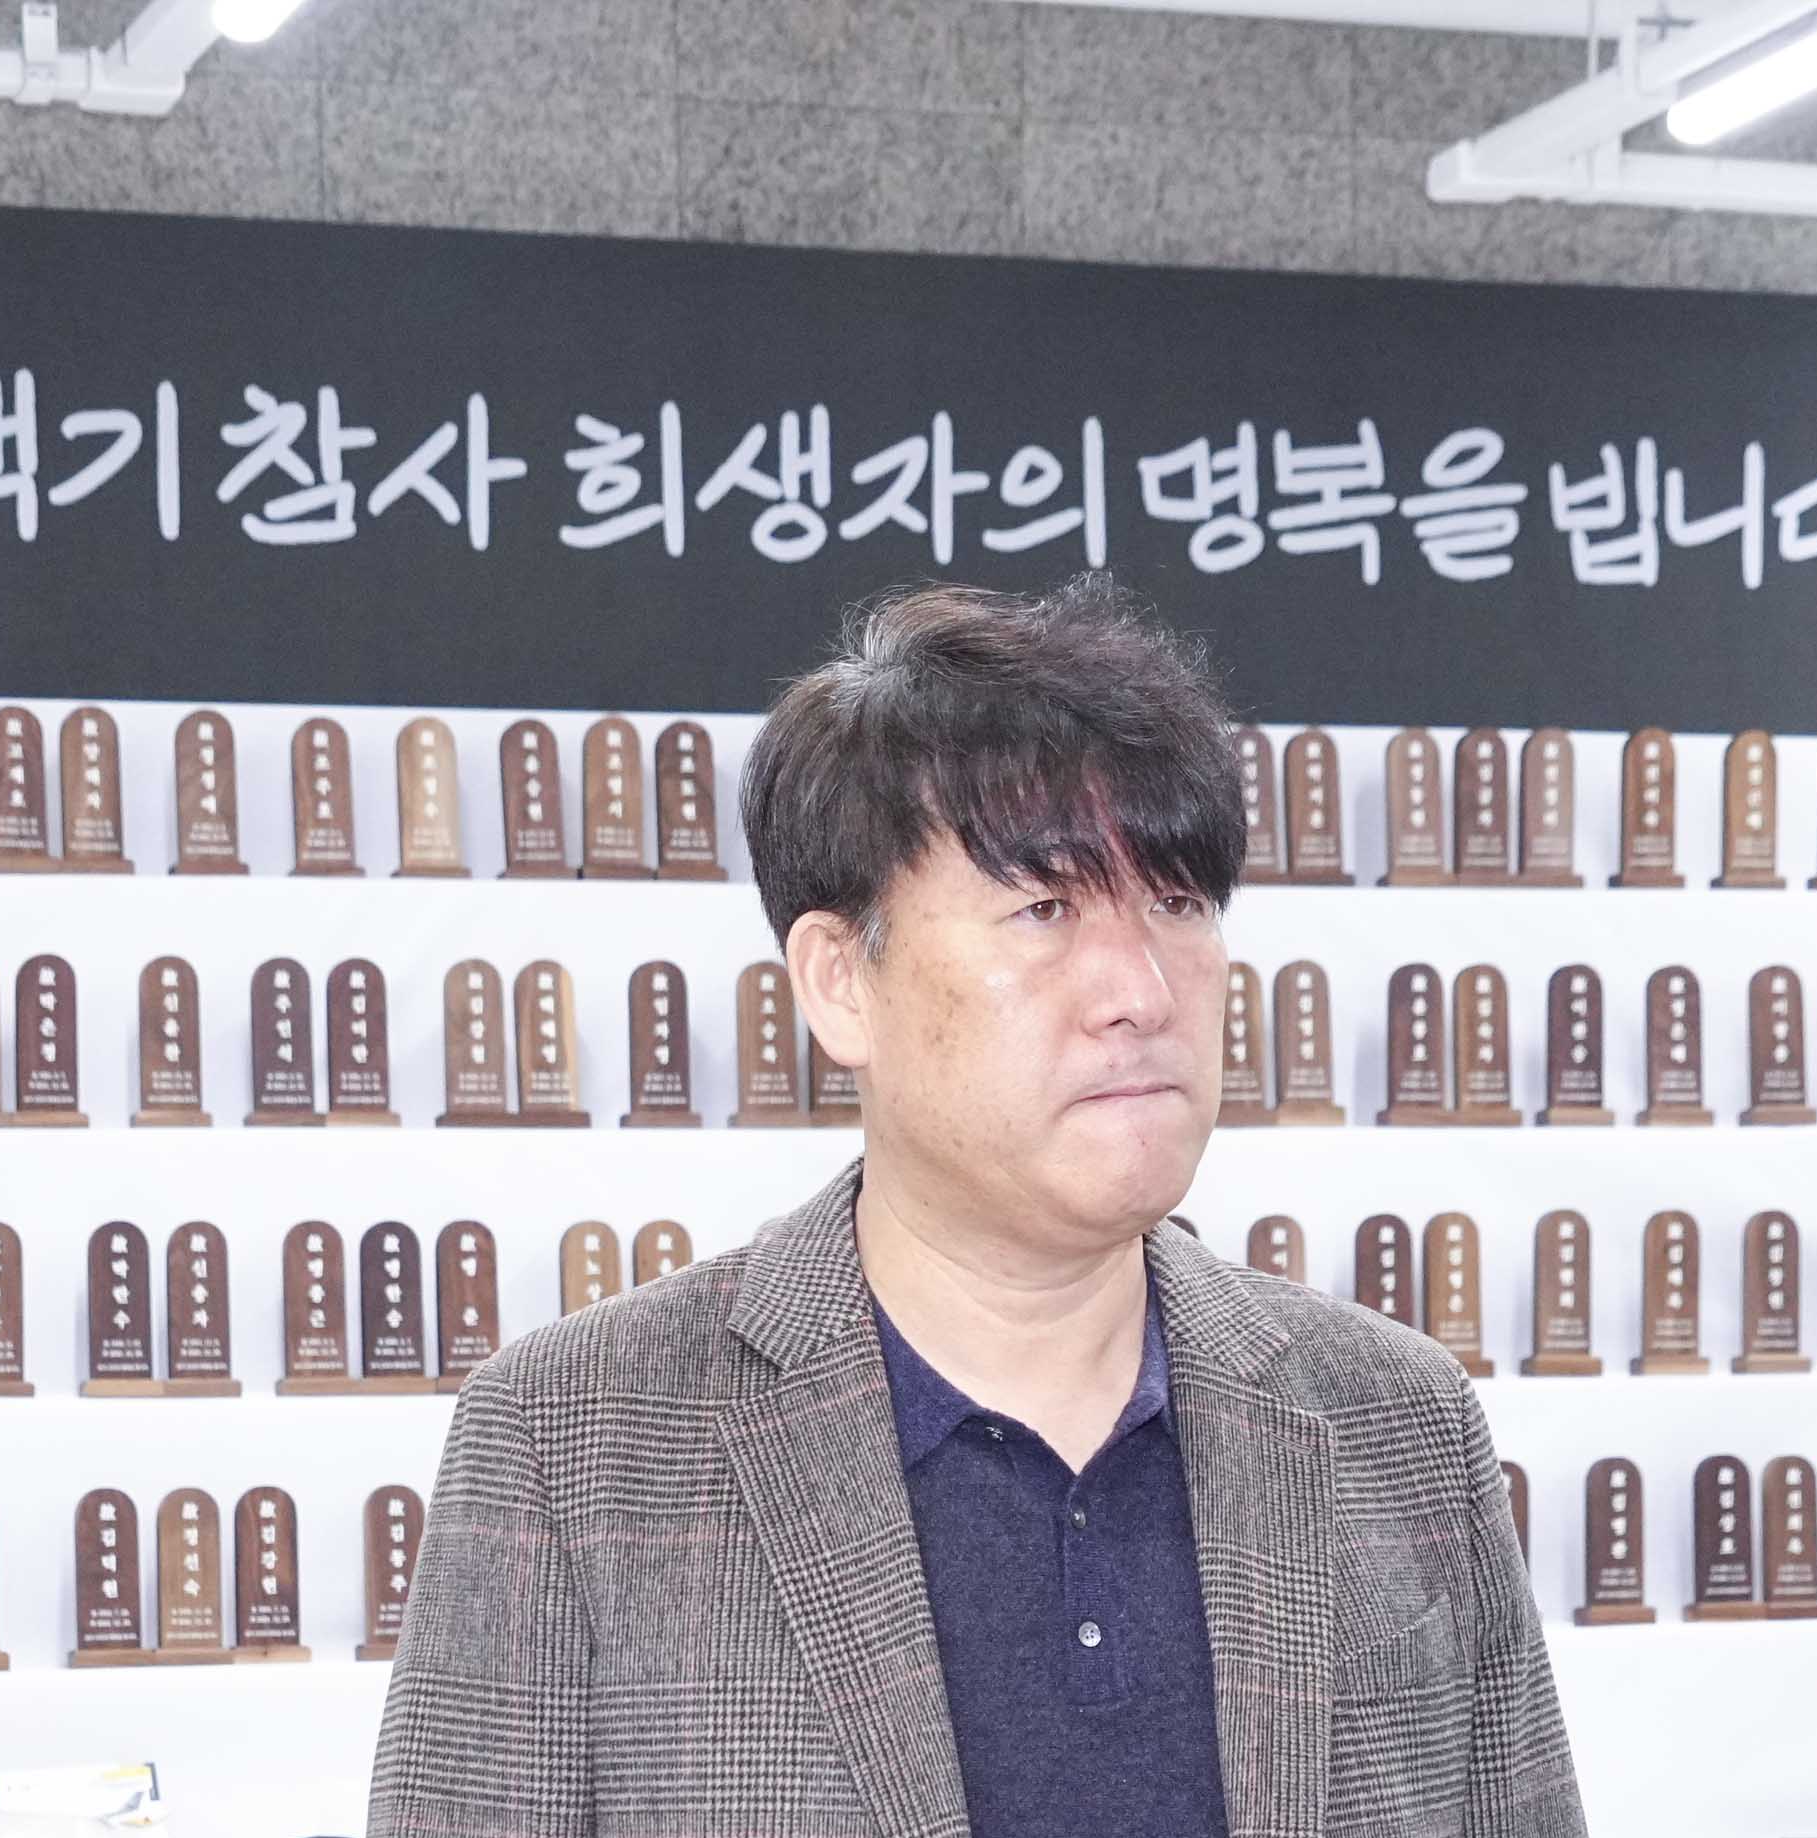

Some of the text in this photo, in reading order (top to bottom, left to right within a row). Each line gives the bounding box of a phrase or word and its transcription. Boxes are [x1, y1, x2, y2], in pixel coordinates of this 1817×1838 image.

[218, 387, 526, 549] 참사
[561, 403, 1105, 566] 희생자의
[1139, 421, 1526, 583] 명복을
